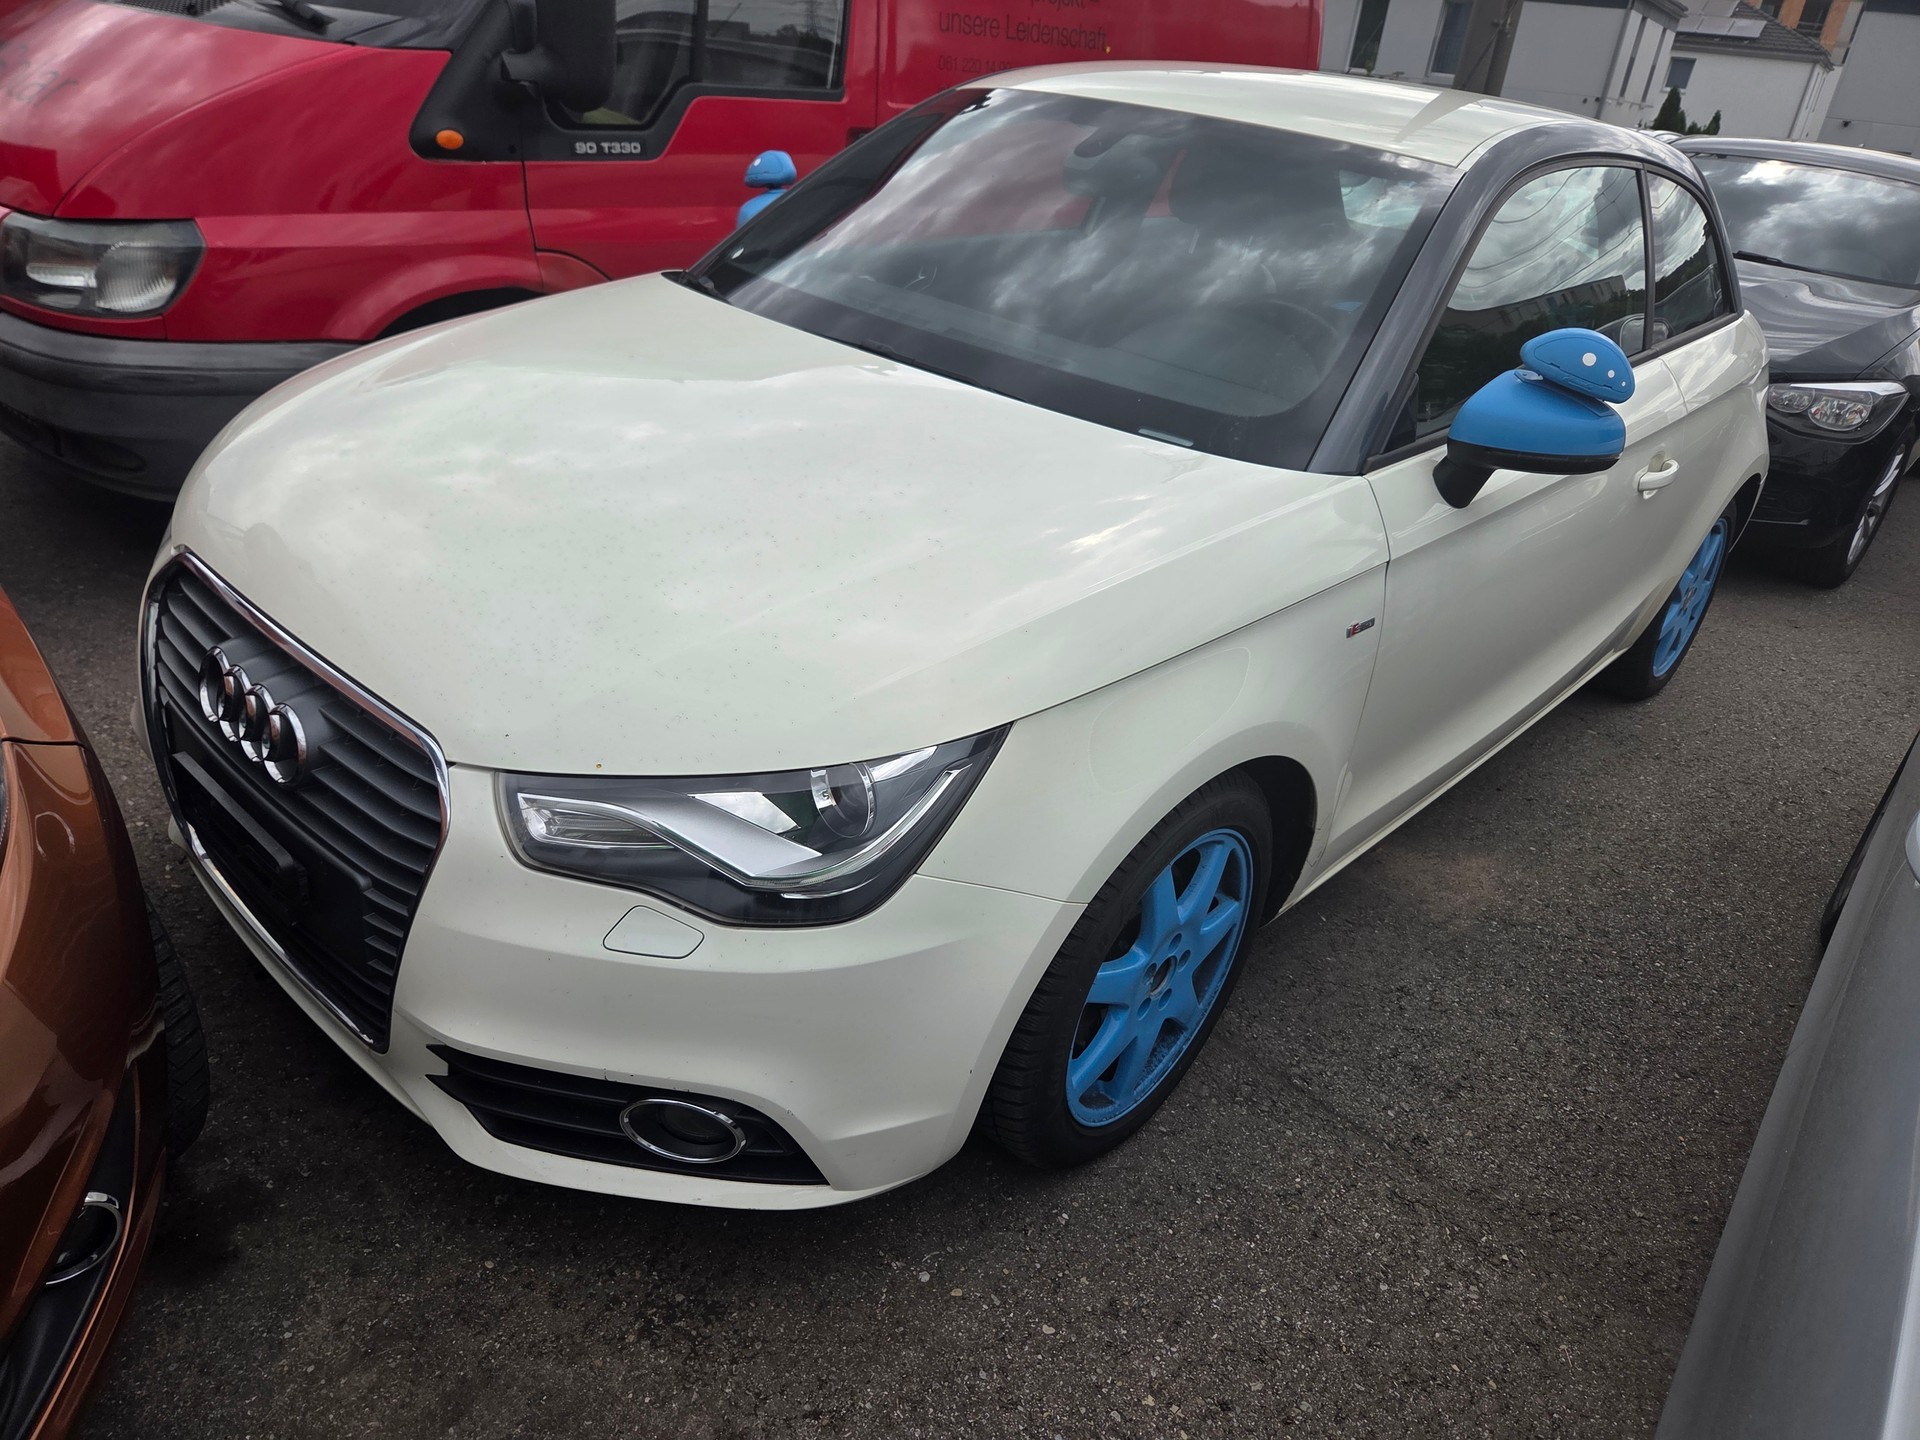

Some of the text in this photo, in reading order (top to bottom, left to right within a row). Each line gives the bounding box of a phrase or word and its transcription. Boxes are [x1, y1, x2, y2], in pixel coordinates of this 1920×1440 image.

[938, 11, 1107, 50] unsere Leidenschaft
[600, 141, 642, 155] T330
